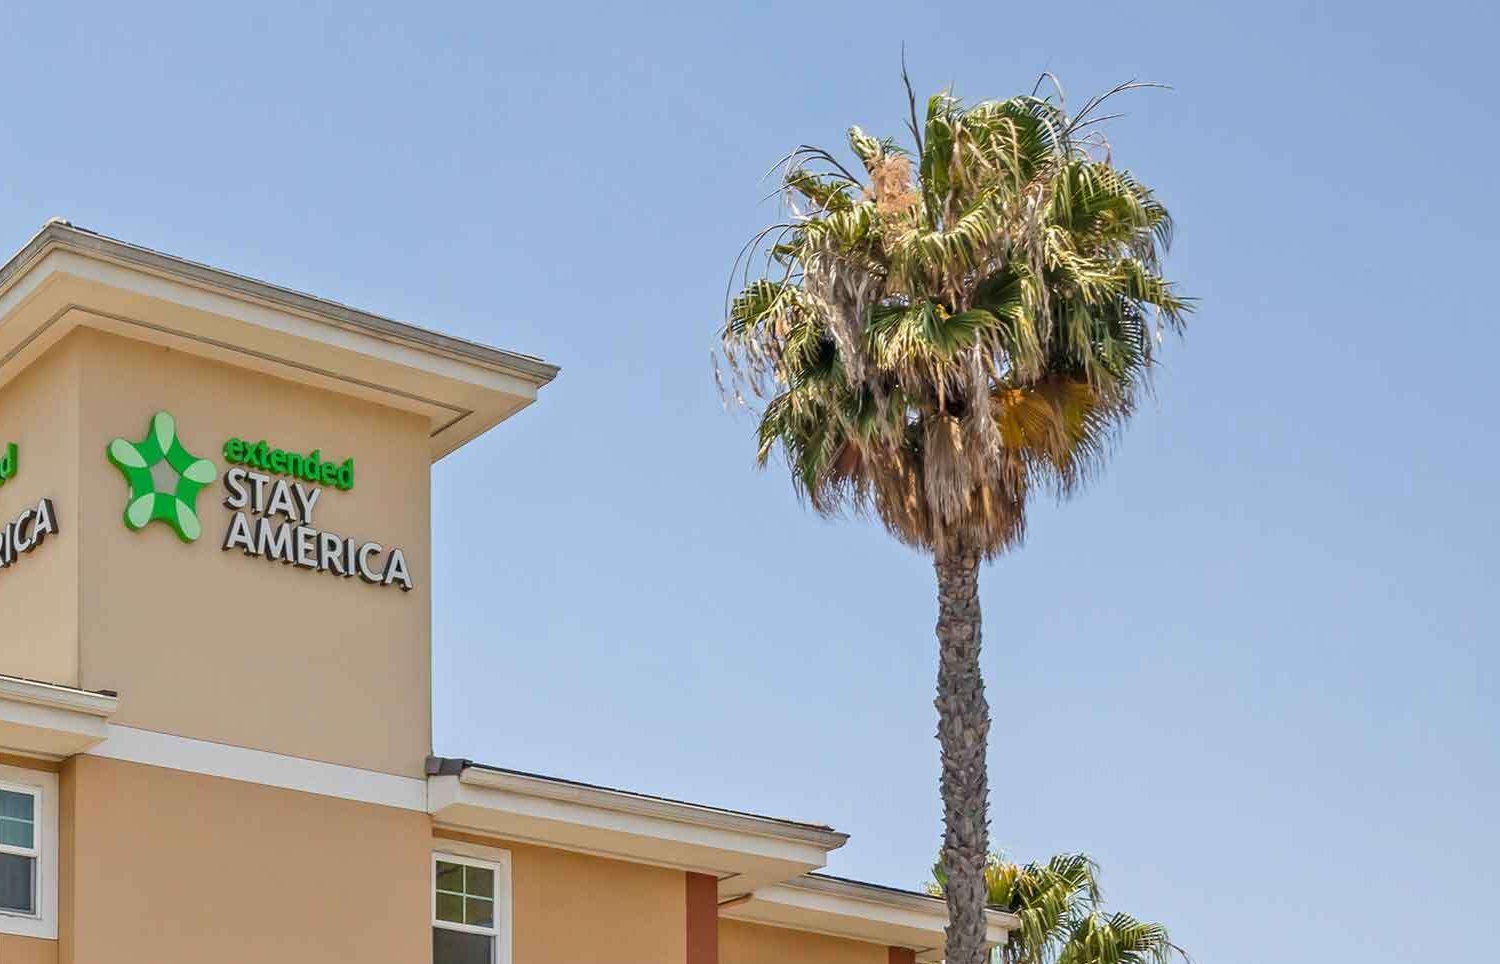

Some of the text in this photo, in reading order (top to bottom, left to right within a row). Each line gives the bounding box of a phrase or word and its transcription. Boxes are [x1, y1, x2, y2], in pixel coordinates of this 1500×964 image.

[223, 437, 354, 490] extended
[224, 467, 321, 525] STAY
[223, 511, 413, 591] AMERICA
